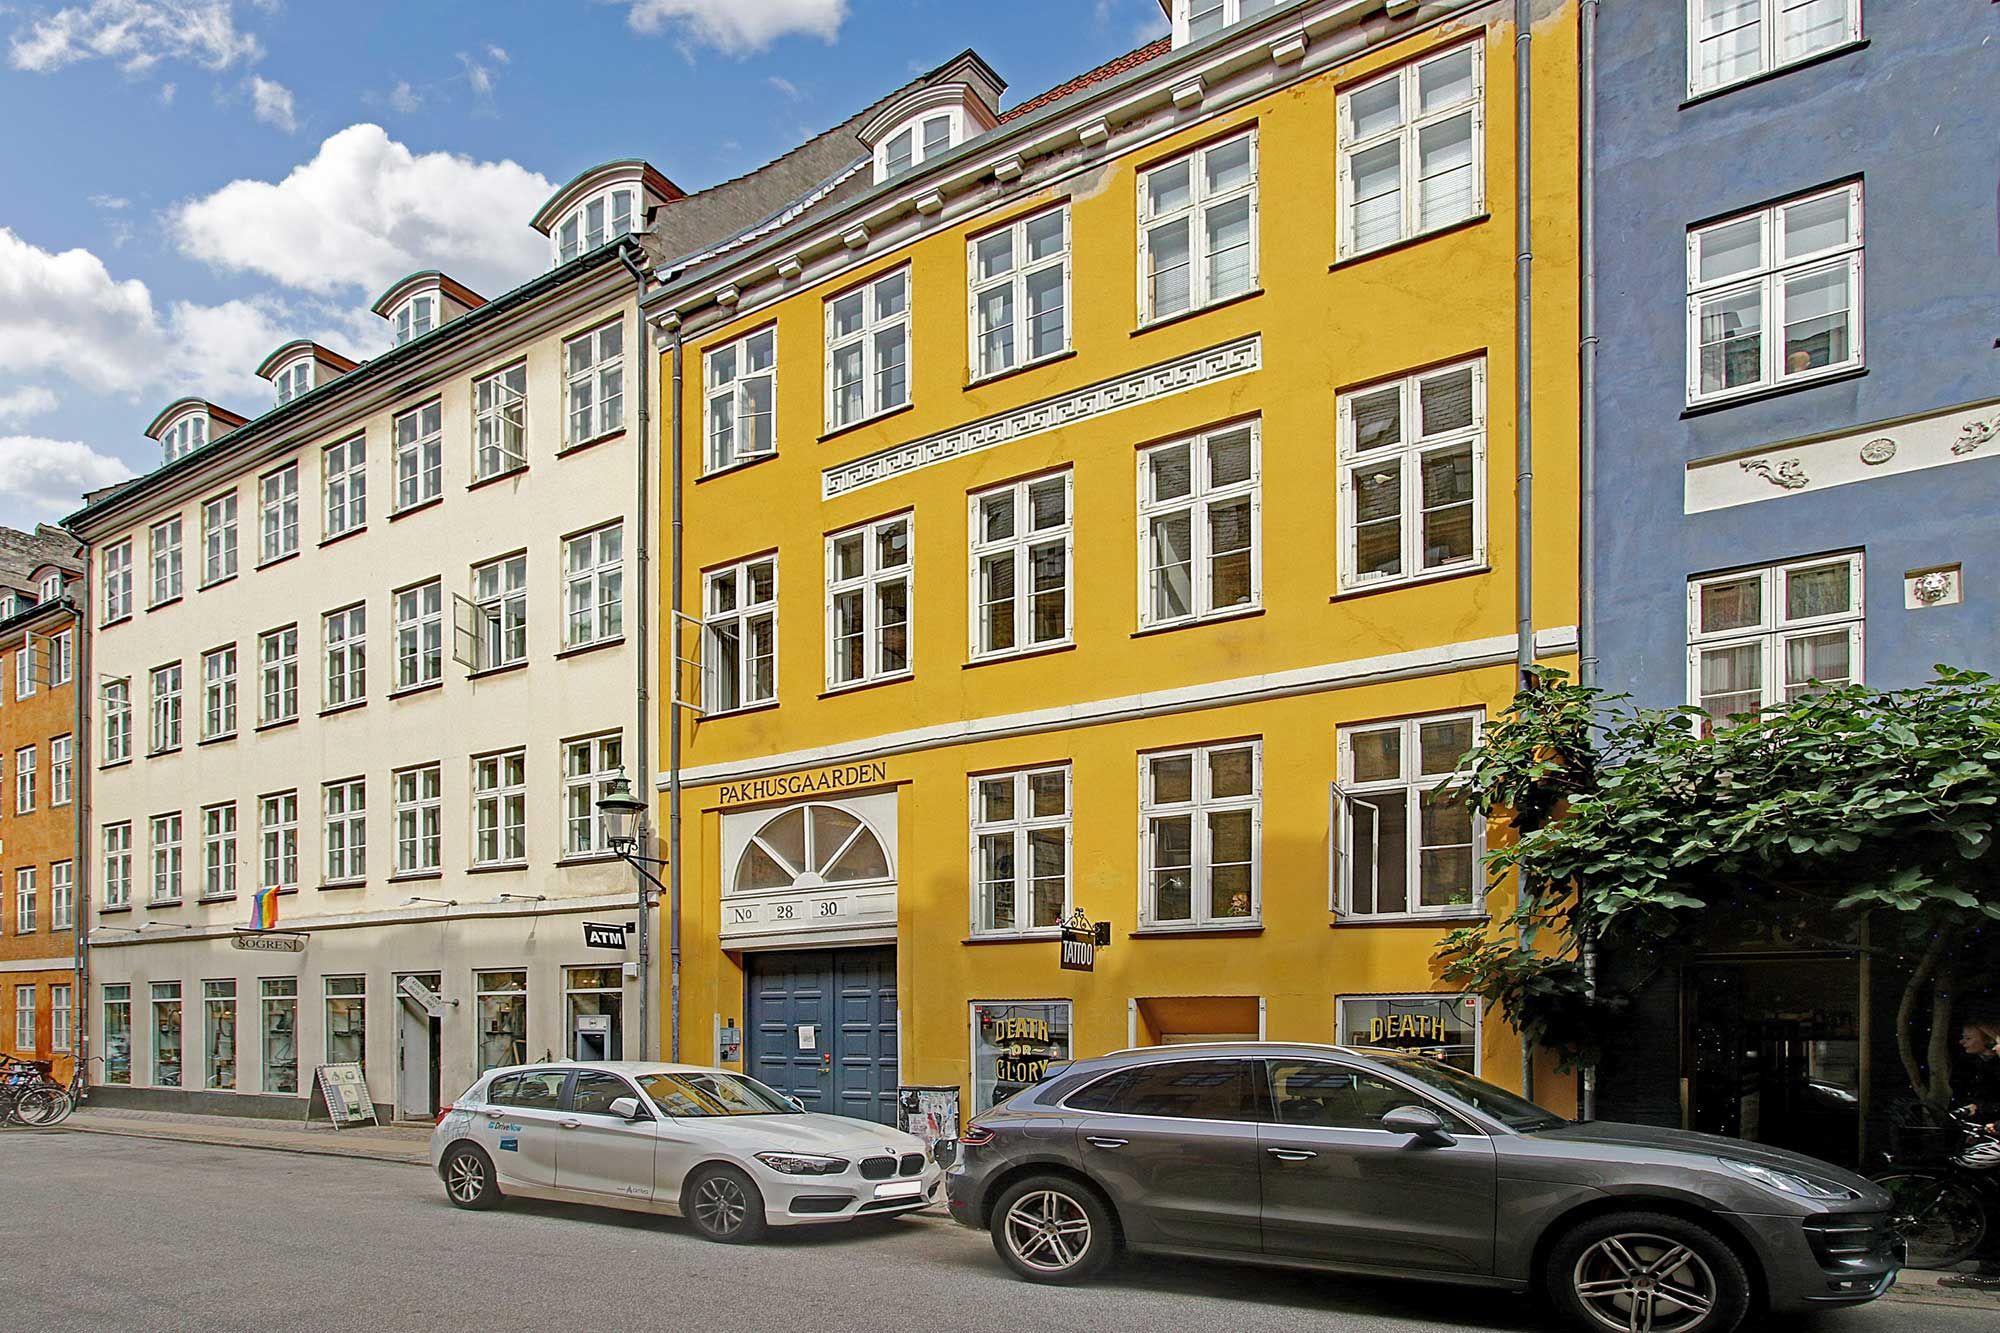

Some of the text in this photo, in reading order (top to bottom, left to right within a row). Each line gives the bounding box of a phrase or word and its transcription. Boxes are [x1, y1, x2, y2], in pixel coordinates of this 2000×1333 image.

[720, 761, 886, 804] PAKHUSGAARDEN
[776, 905, 794, 919] 28
[820, 901, 838, 916] 30
[590, 930, 622, 945] ATM
[1063, 940, 1093, 966] TATTOO
[995, 1016, 1049, 1042] DEATH
[1369, 1014, 1446, 1043] DEATH
[1010, 1044, 1032, 1056] OR
[996, 1059, 1049, 1082] GLORY
